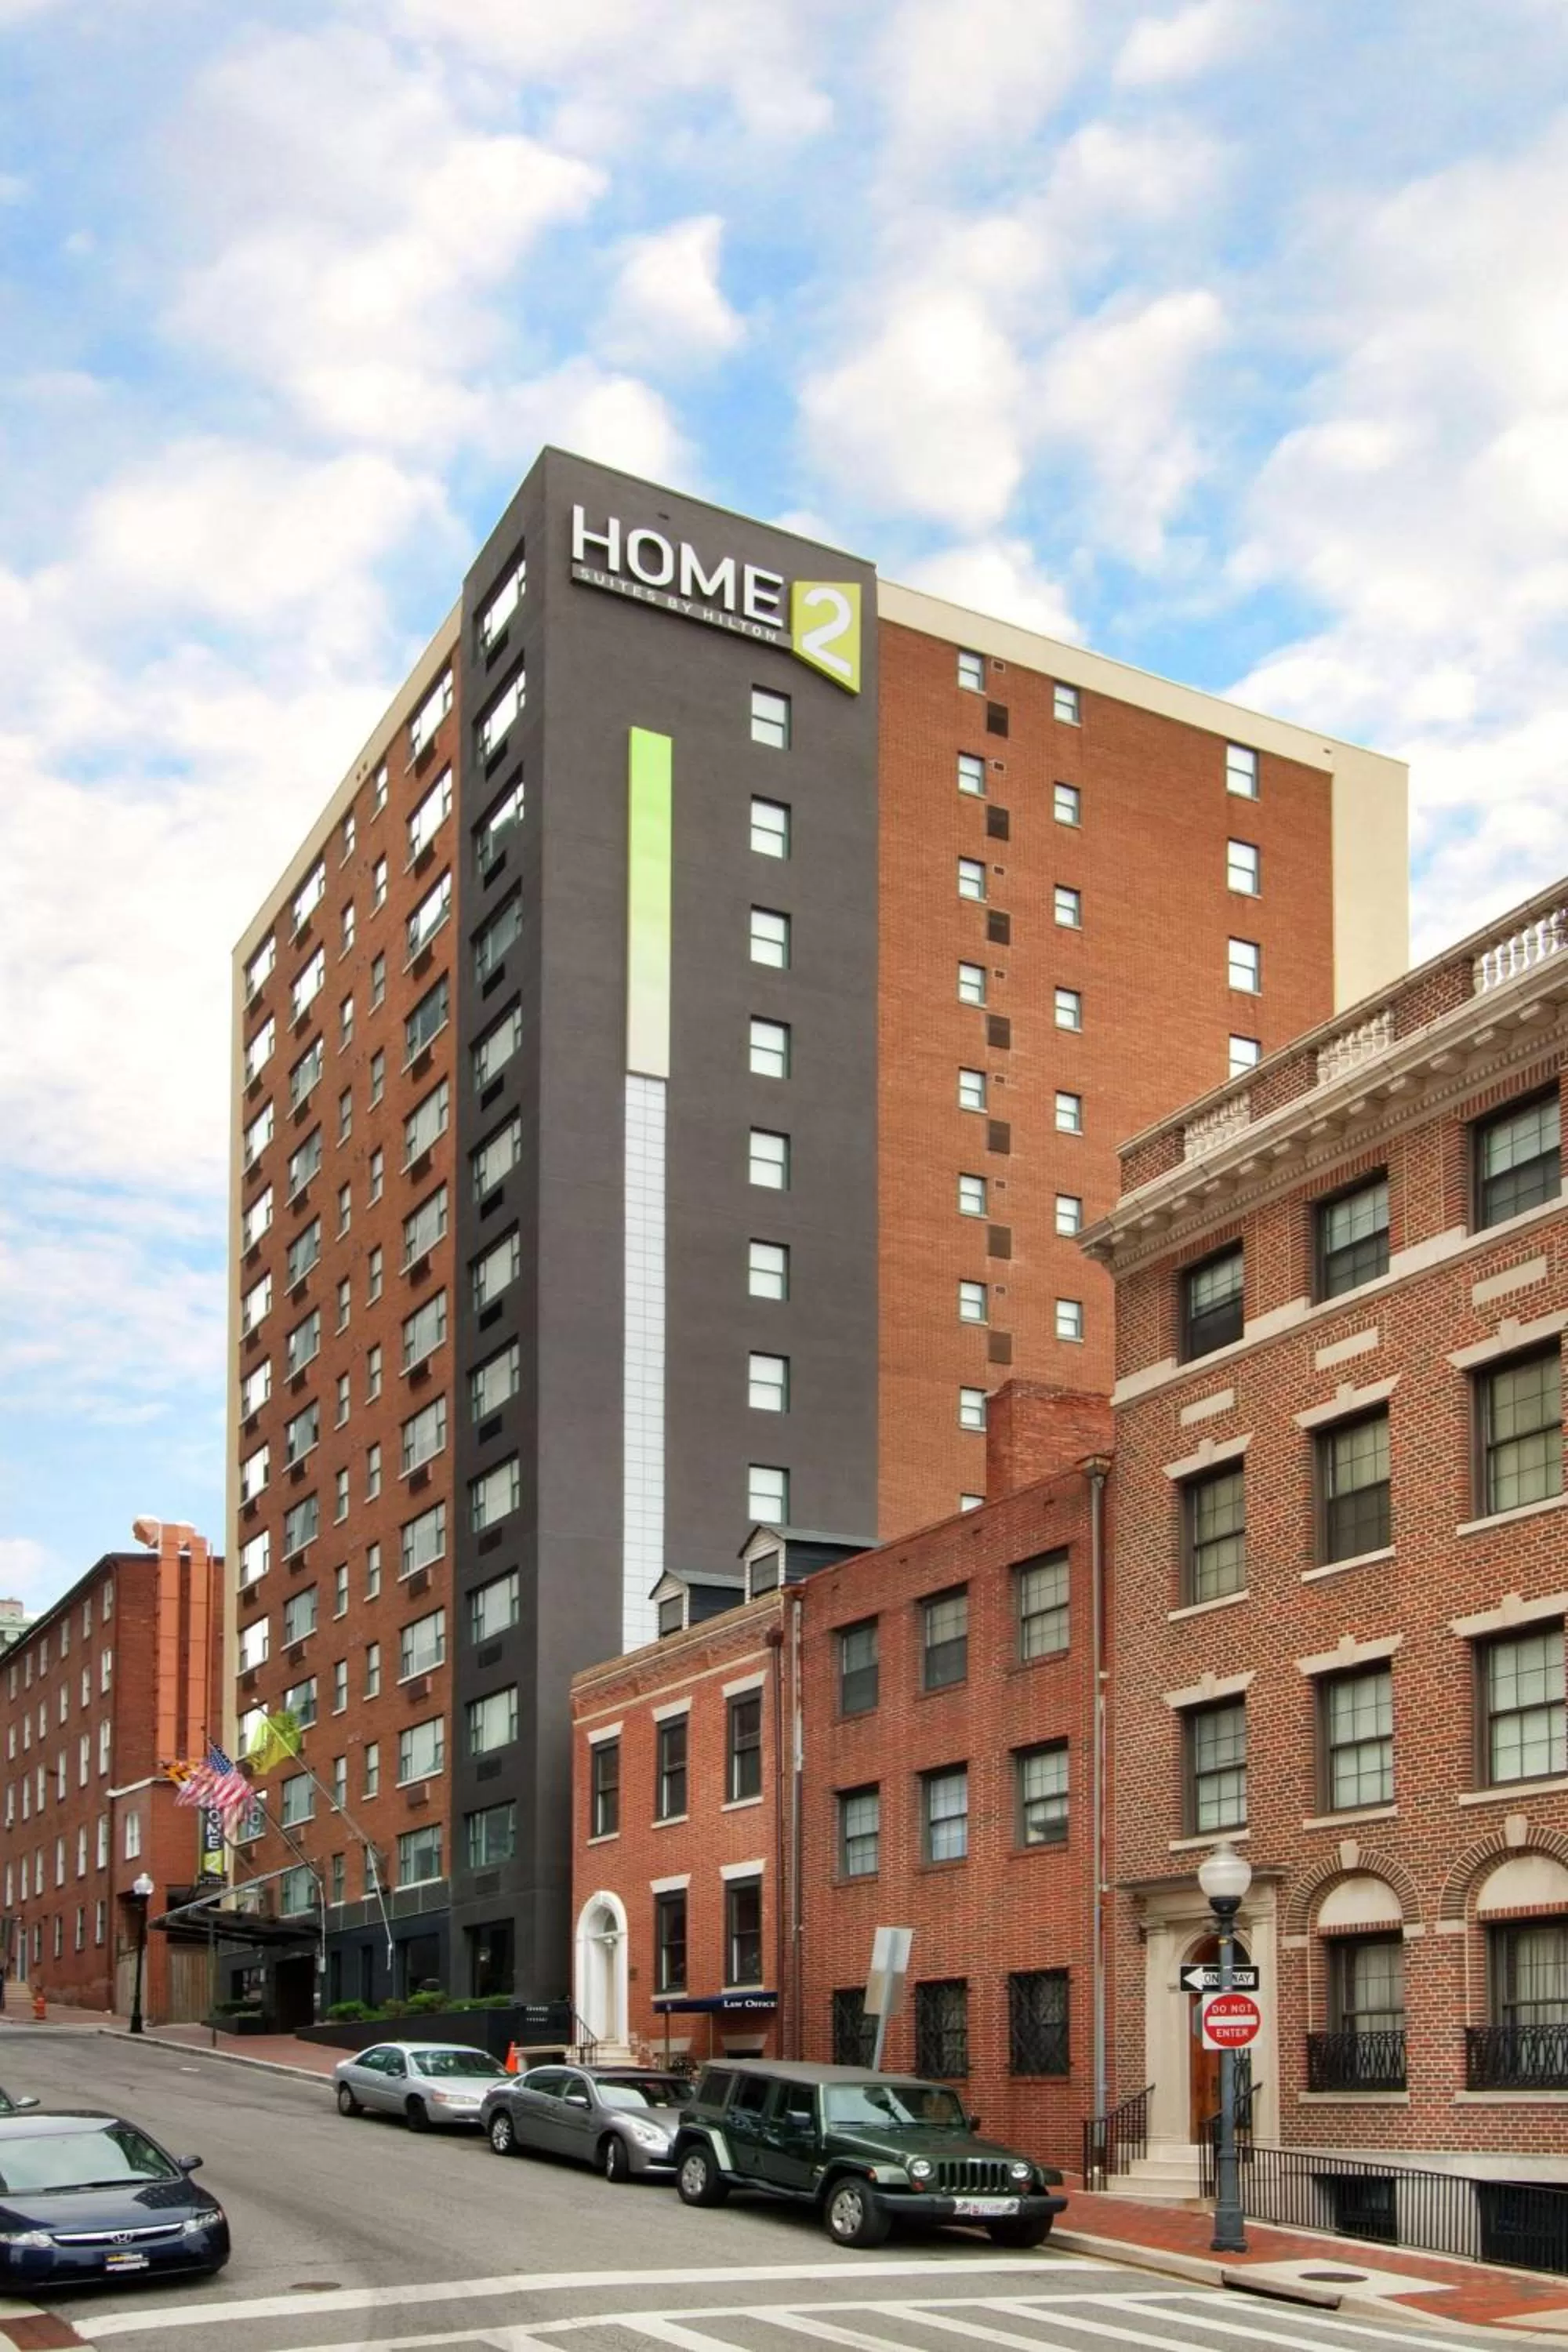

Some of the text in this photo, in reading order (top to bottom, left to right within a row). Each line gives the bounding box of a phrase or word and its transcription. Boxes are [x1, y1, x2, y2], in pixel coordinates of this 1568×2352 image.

[572, 503, 852, 678] HOME 2
[580, 567, 777, 642] SUITES BY HILTON
[206, 1809, 222, 1849] OME
[1204, 1973, 1221, 1984] ON
[1211, 2003, 1252, 2014] DO NOT
[1216, 2028, 1249, 2038] ENTER
